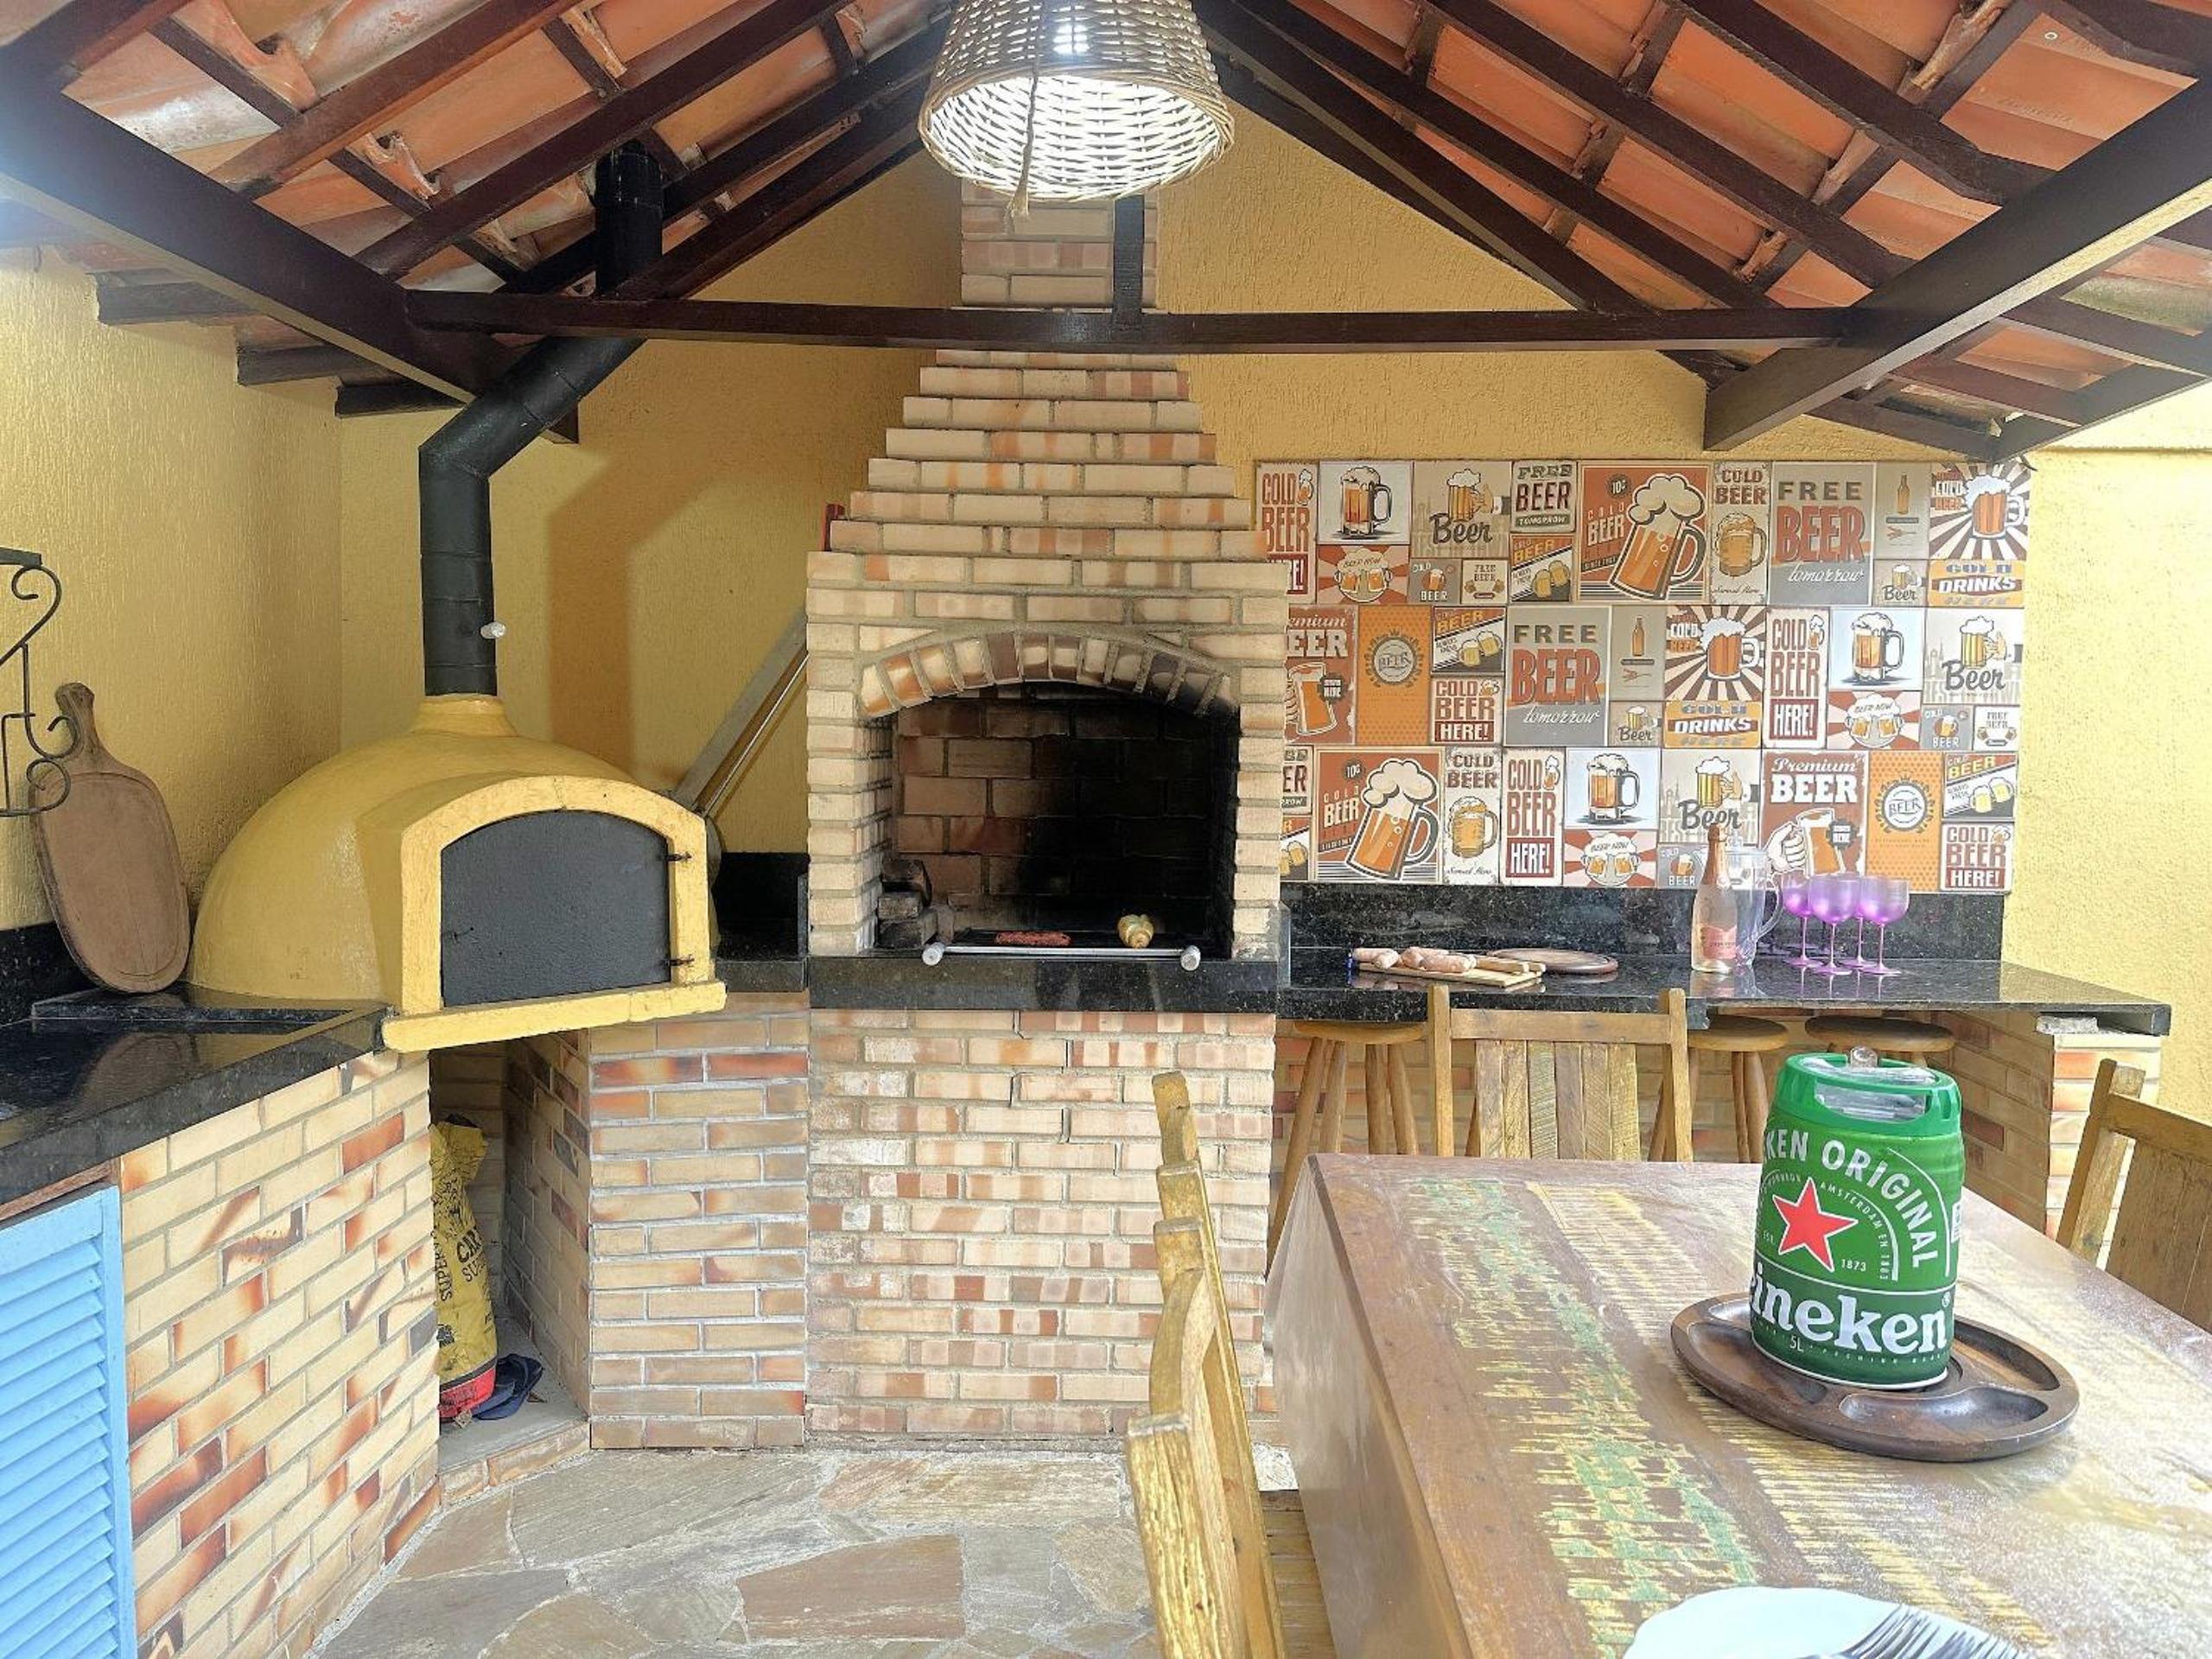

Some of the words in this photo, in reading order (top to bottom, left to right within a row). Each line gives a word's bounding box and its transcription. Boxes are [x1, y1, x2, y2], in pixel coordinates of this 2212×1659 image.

[1517, 464, 1573, 480] FREE
[1721, 467, 1764, 483] COLD
[1262, 473, 1296, 505] COLD
[1516, 480, 1573, 512] BEER
[1715, 485, 1767, 505] BEER
[1777, 480, 1863, 501] FREE
[1518, 515, 1567, 526] TOMORROW
[1587, 501, 1625, 521] COLD
[1262, 506, 1310, 552] BEER
[1429, 512, 1493, 545] Beer
[1587, 513, 1625, 547] BEER
[1775, 505, 1866, 563] BEER
[1514, 539, 1555, 565] BEER
[1787, 564, 1866, 582] tomorrow
[1884, 584, 1918, 601] Beer
[1938, 575, 2016, 594] DRINKS
[1420, 590, 1448, 601] BEER
[1287, 614, 1348, 628] emium
[1437, 610, 1484, 634] BEER
[1670, 623, 1698, 638] COLD
[1287, 629, 1349, 658] EER
[1513, 625, 1597, 644] FREE
[1772, 619, 1807, 651] COLD
[1378, 652, 1413, 671] BEER
[1512, 648, 1600, 705] BEER
[1770, 651, 1821, 697] BEER
[1942, 659, 2005, 690] Beer
[1436, 680, 1478, 696] COLD
[1435, 696, 1495, 721] BEER
[1523, 706, 1600, 724] tomorrow
[1675, 717, 1751, 734] DRINKS
[1774, 703, 1815, 737] HERE!
[1440, 723, 1489, 740] HERE!
[1618, 726, 1652, 741] Beer
[1933, 737, 1960, 748] BEER
[1452, 753, 1495, 768] COLD
[1771, 758, 1857, 773] Premium
[1948, 755, 1995, 780] BEER
[1282, 765, 1307, 792] ER
[1446, 770, 1499, 788] BEER
[1508, 759, 1542, 791] COLD
[1770, 773, 1858, 804] BEER
[1324, 797, 1360, 828] BEER
[1507, 791, 1556, 836] BEER
[1678, 799, 1742, 830] Beer
[1889, 798, 1923, 817] BEER
[1947, 827, 1987, 843] COLD
[1510, 842, 1550, 874] HERE!
[1946, 843, 2006, 868] BEER
[1669, 875, 1695, 887] BEER
[1951, 870, 2000, 887] HERE!
[1765, 1128, 1809, 1161] KEN
[1821, 1139, 1938, 1268] ORIGINAL
[1820, 1181, 1883, 1230] AMSTERDAM
[1841, 1259, 1866, 1272] 1873
[1751, 1262, 1948, 1355] ineken
[1789, 1335, 1804, 1353] 5L
